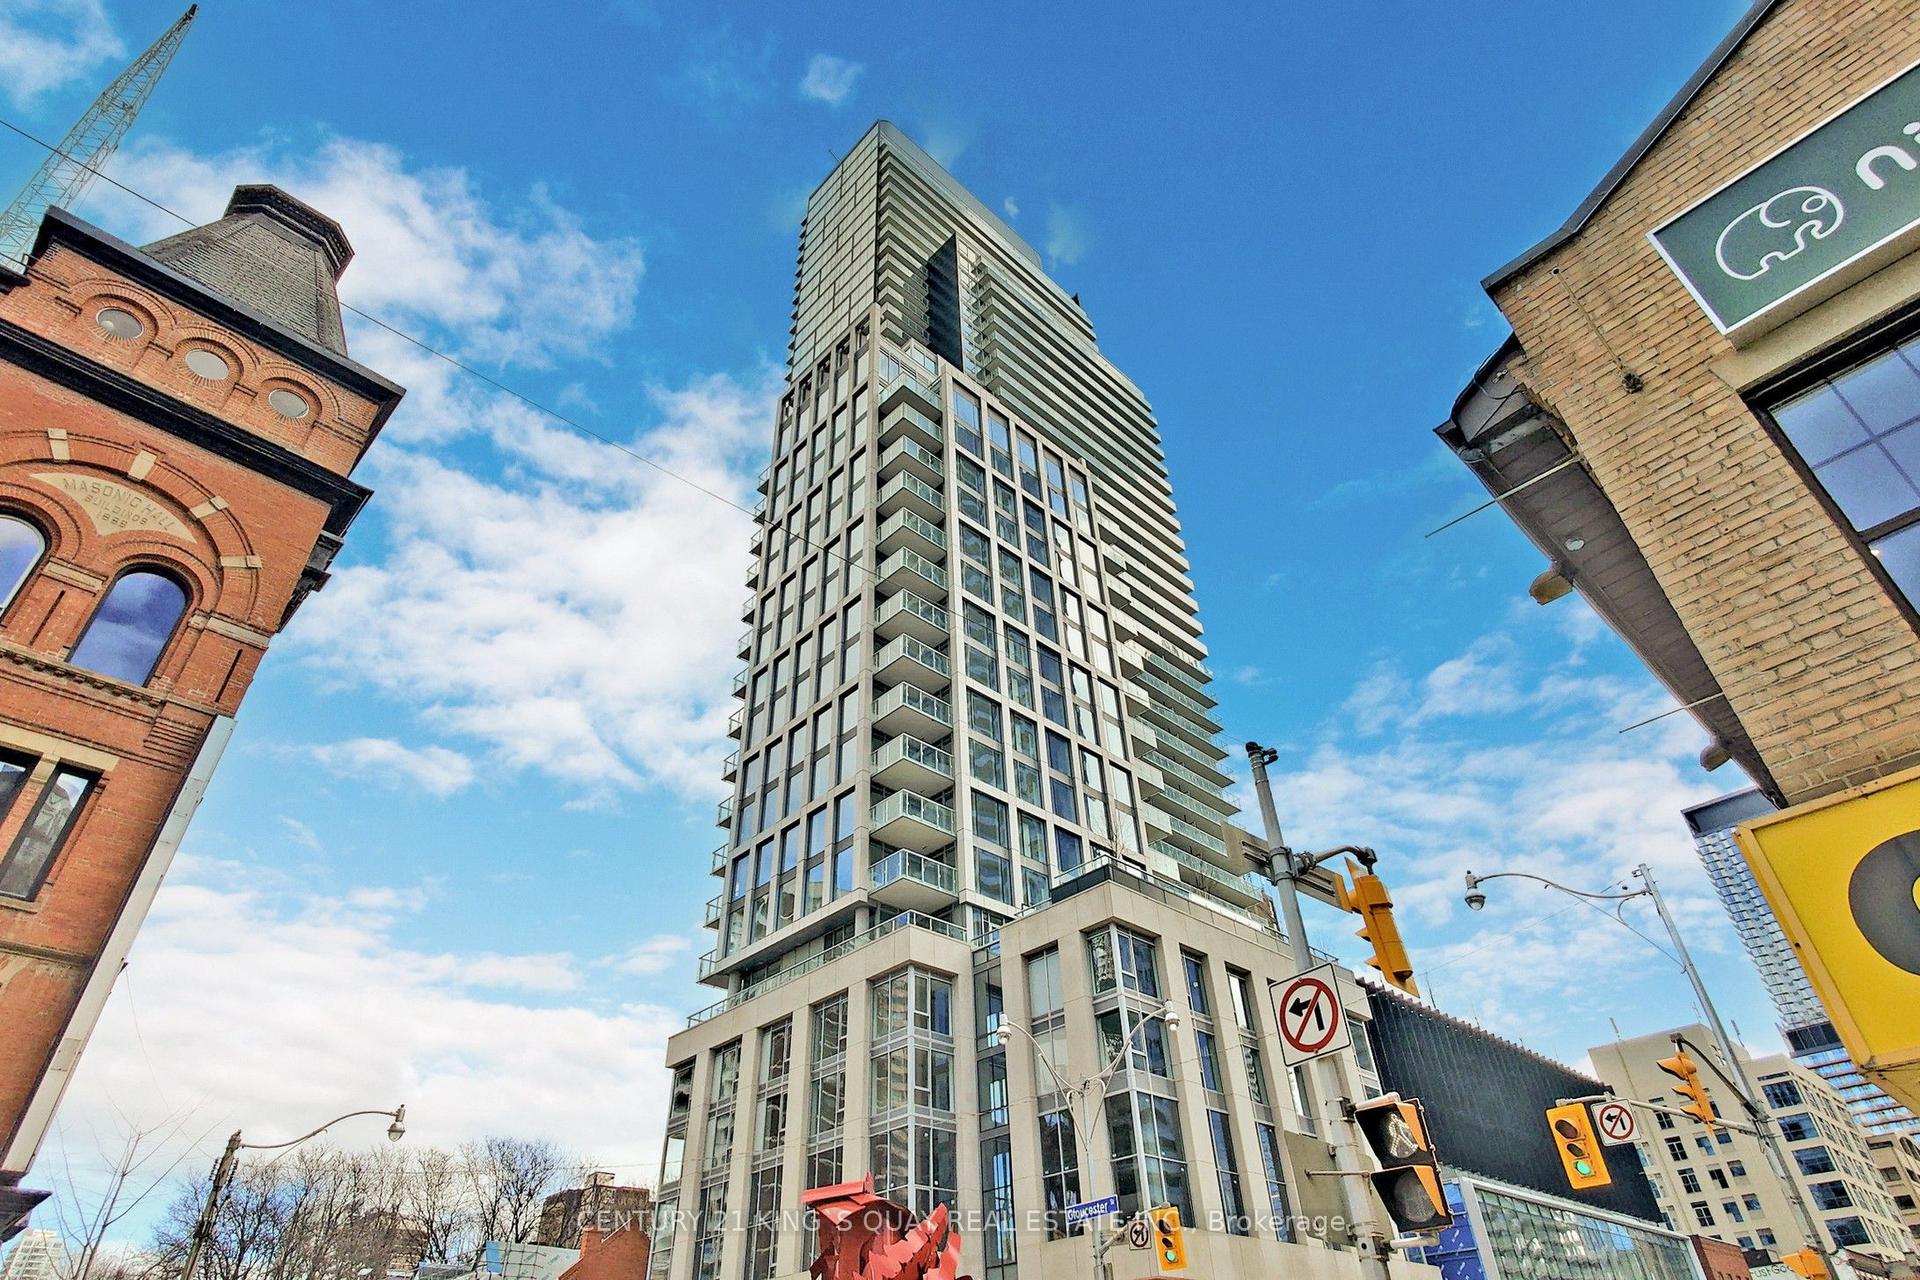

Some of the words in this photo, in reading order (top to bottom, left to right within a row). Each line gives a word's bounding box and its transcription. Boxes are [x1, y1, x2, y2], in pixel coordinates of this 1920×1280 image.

[63, 478, 142, 508] MASONIC
[142, 502, 175, 531] HALL
[1067, 1202, 1108, 1221] Gloucester
